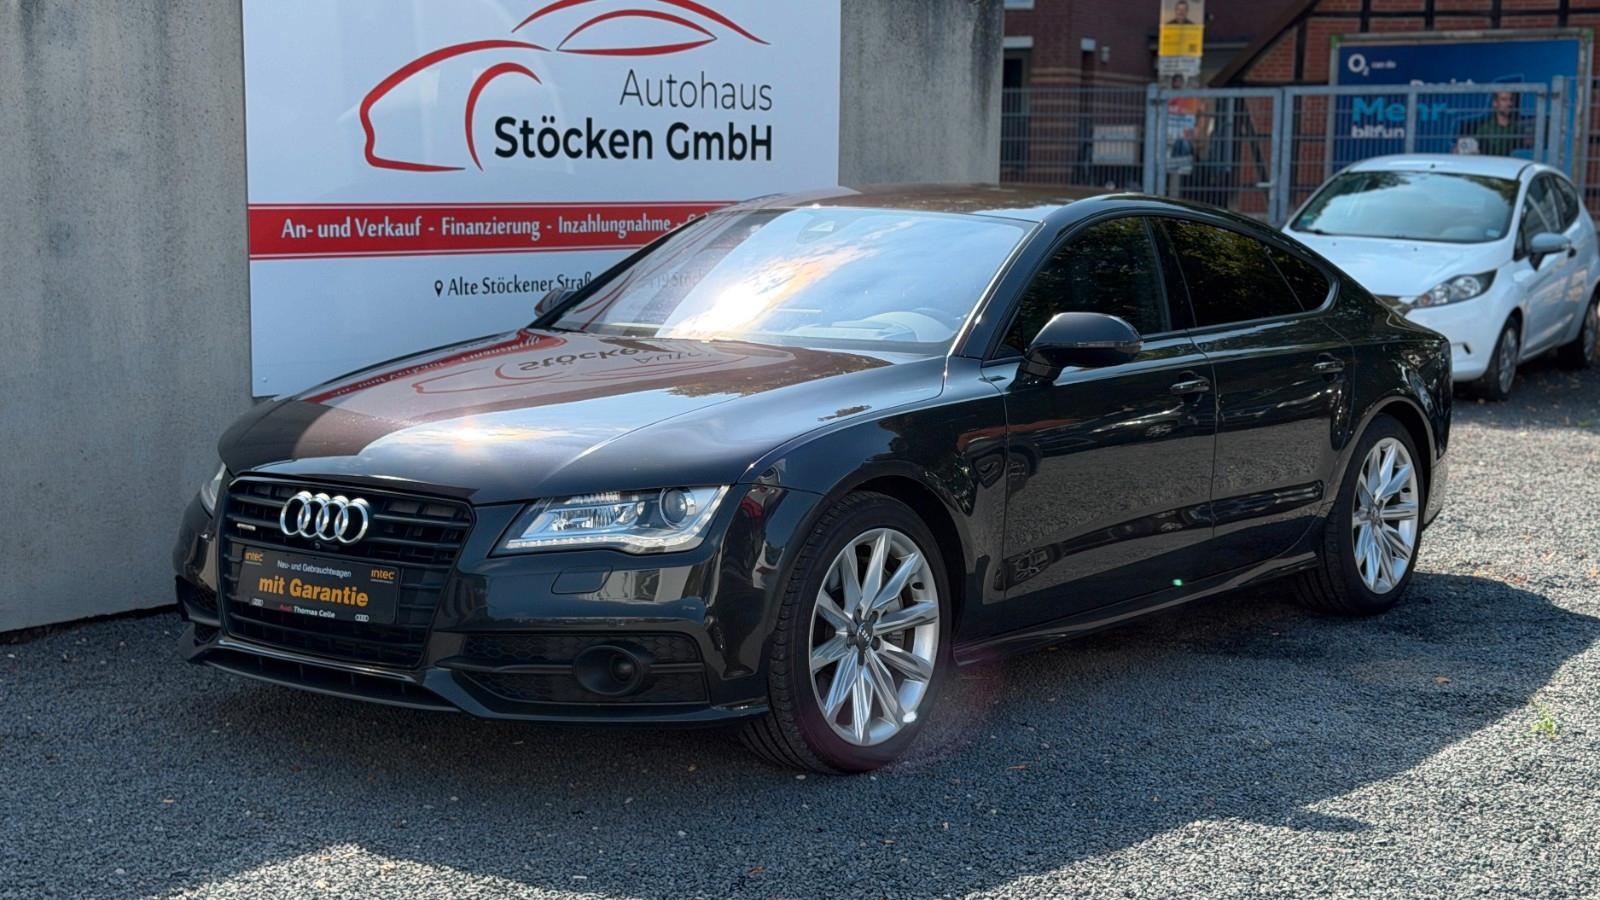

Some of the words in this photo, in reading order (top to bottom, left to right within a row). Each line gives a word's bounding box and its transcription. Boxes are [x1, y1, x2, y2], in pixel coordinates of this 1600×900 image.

[620, 68, 773, 111] Autohaus
[494, 115, 653, 159] Stöcken
[666, 122, 772, 161] GmbH
[1351, 125, 1405, 139] bilfun
[281, 218, 313, 239] An-
[317, 216, 351, 238] und
[355, 215, 422, 237] Verkauf
[441, 216, 541, 241] Finanzierung
[558, 213, 671, 239] Inzahlungnahme
[447, 276, 478, 296] Alte
[482, 274, 554, 295] Stöckener
[557, 271, 592, 290] Straß
[291, 563, 302, 571] und
[302, 563, 352, 579] Gebrauchtwagen
[371, 569, 395, 580] intec
[258, 575, 285, 595] mit
[289, 578, 369, 607] Garantie
[293, 605, 318, 617] Thomas
[318, 609, 336, 619] Celle
